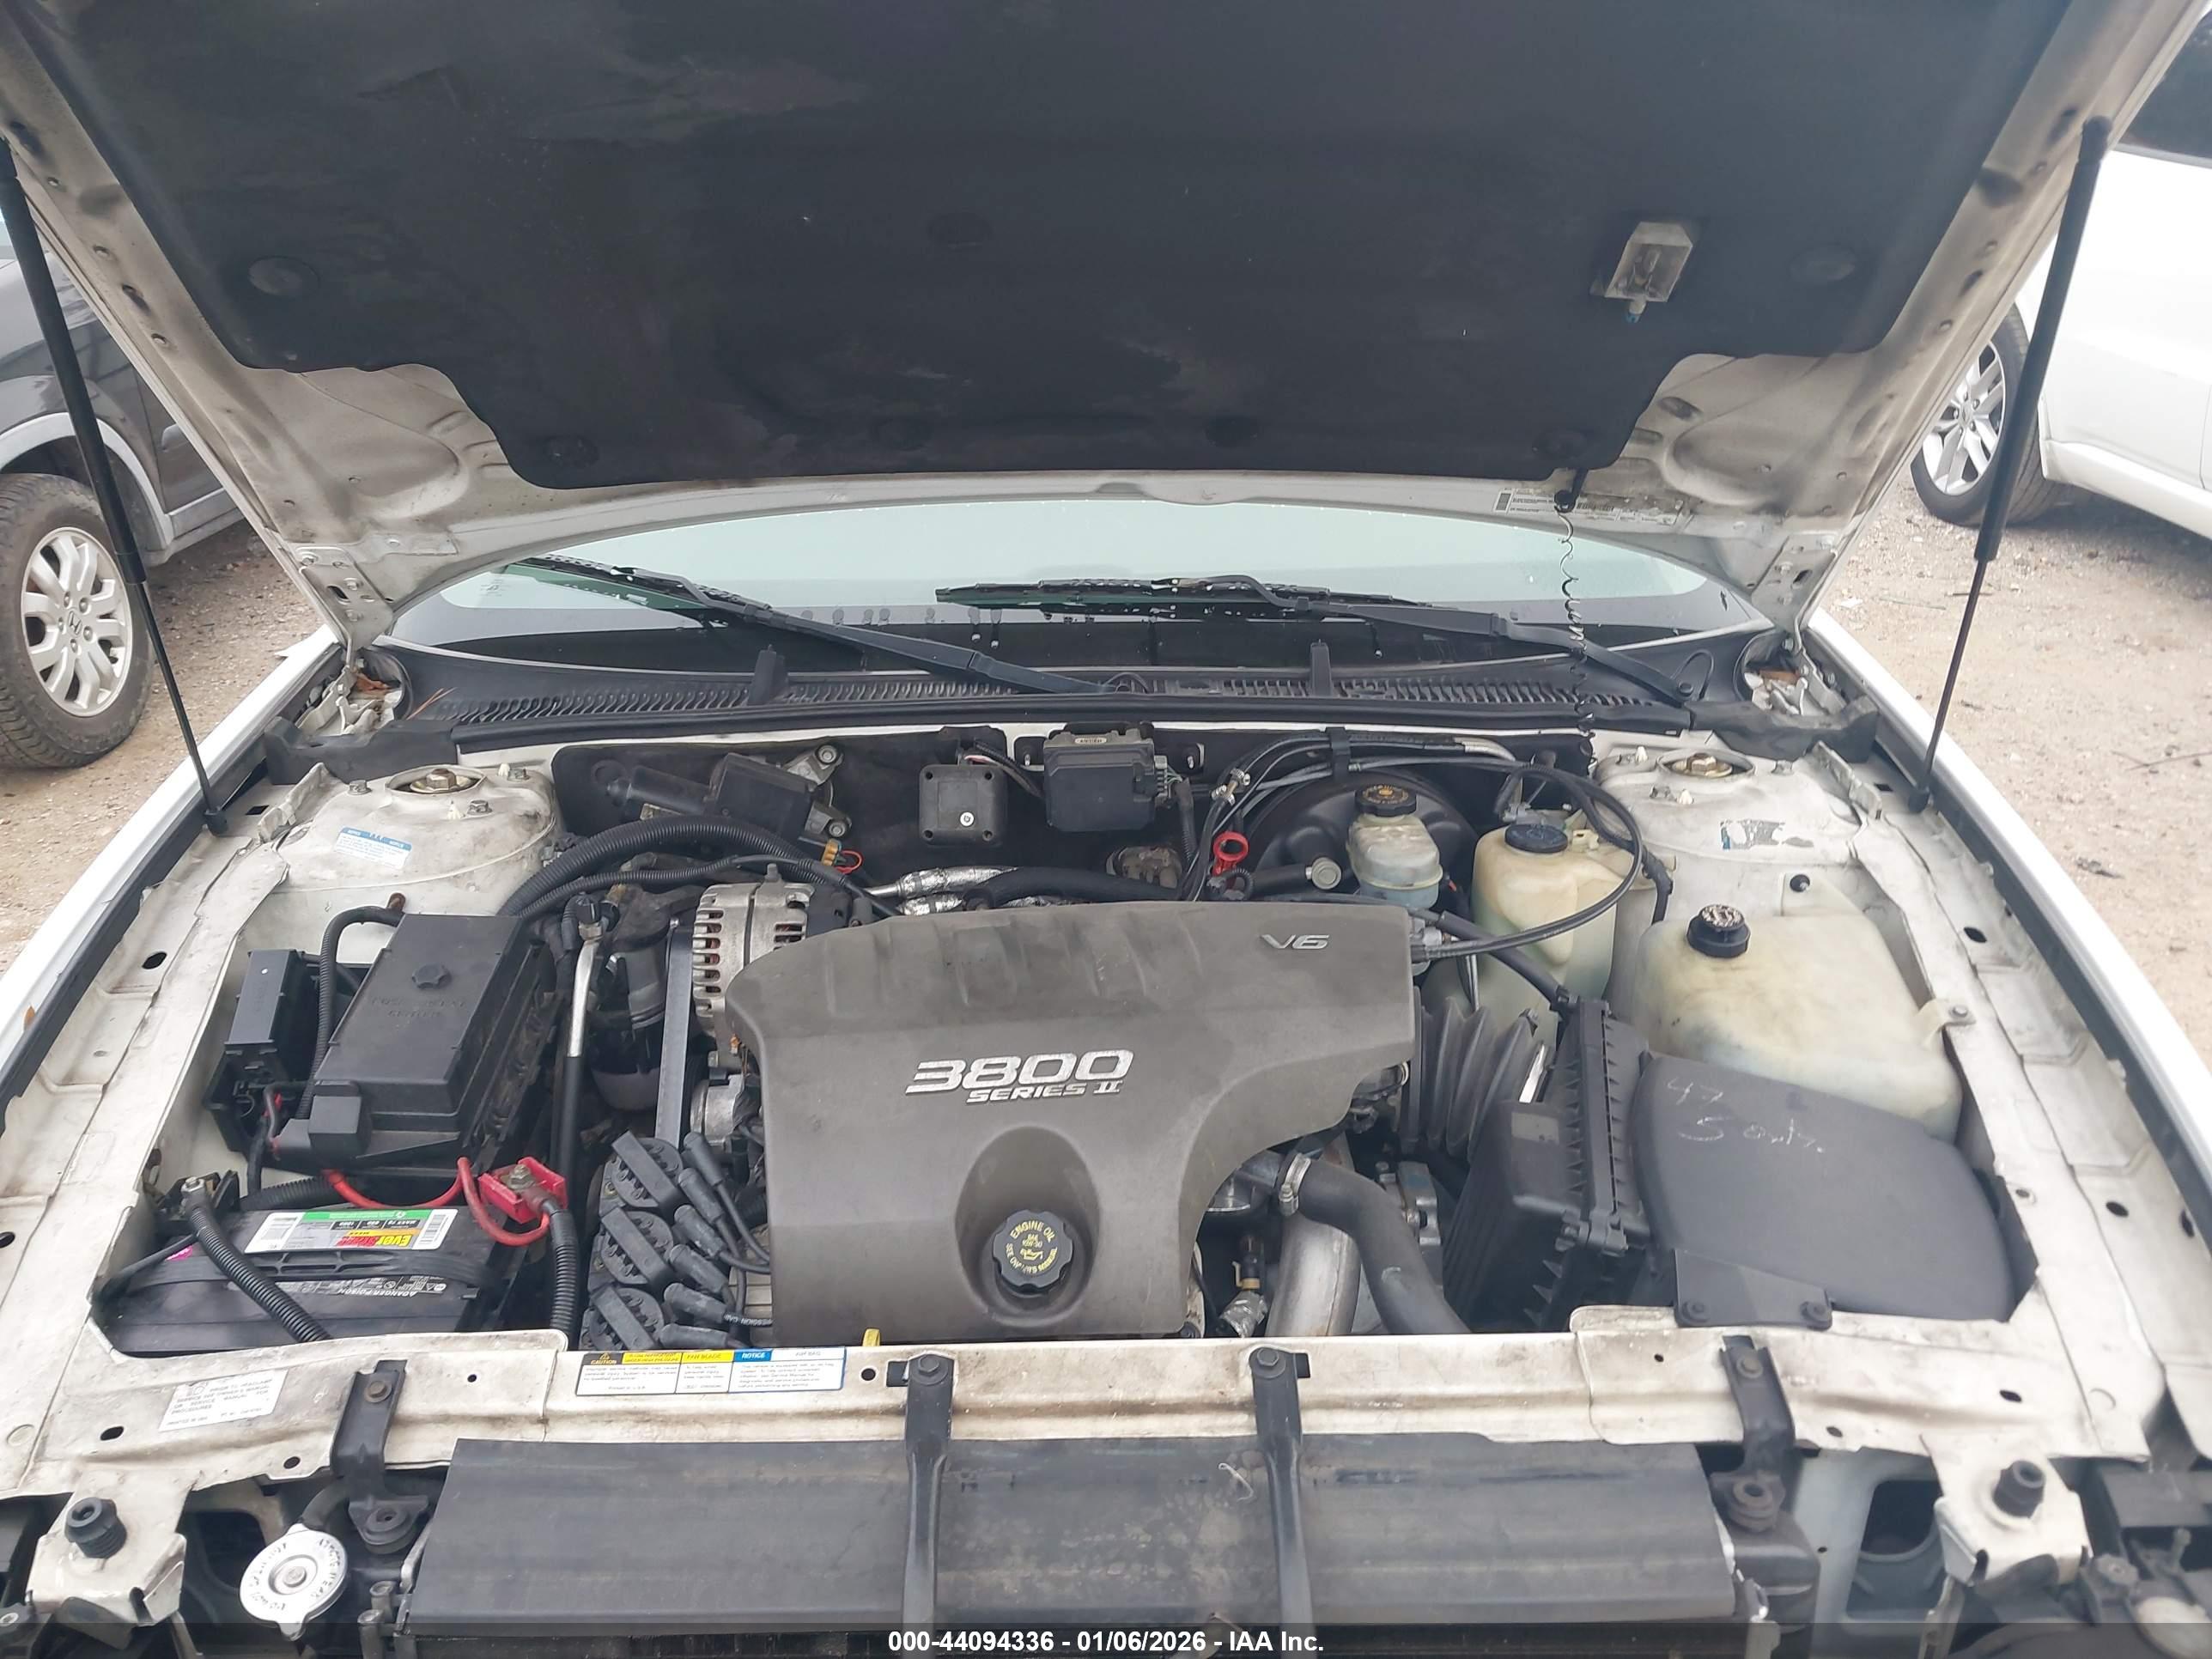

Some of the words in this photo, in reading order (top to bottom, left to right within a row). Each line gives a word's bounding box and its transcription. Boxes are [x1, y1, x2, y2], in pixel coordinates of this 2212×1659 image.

[1261, 933, 1330, 950] V6
[905, 1049, 1134, 1096] 3800
[966, 1082, 1088, 1104] SERIES
[1009, 1220, 1045, 1240] ENGINE
[1042, 1226, 1056, 1243] OIL
[1006, 1243, 1014, 1259] SEE
